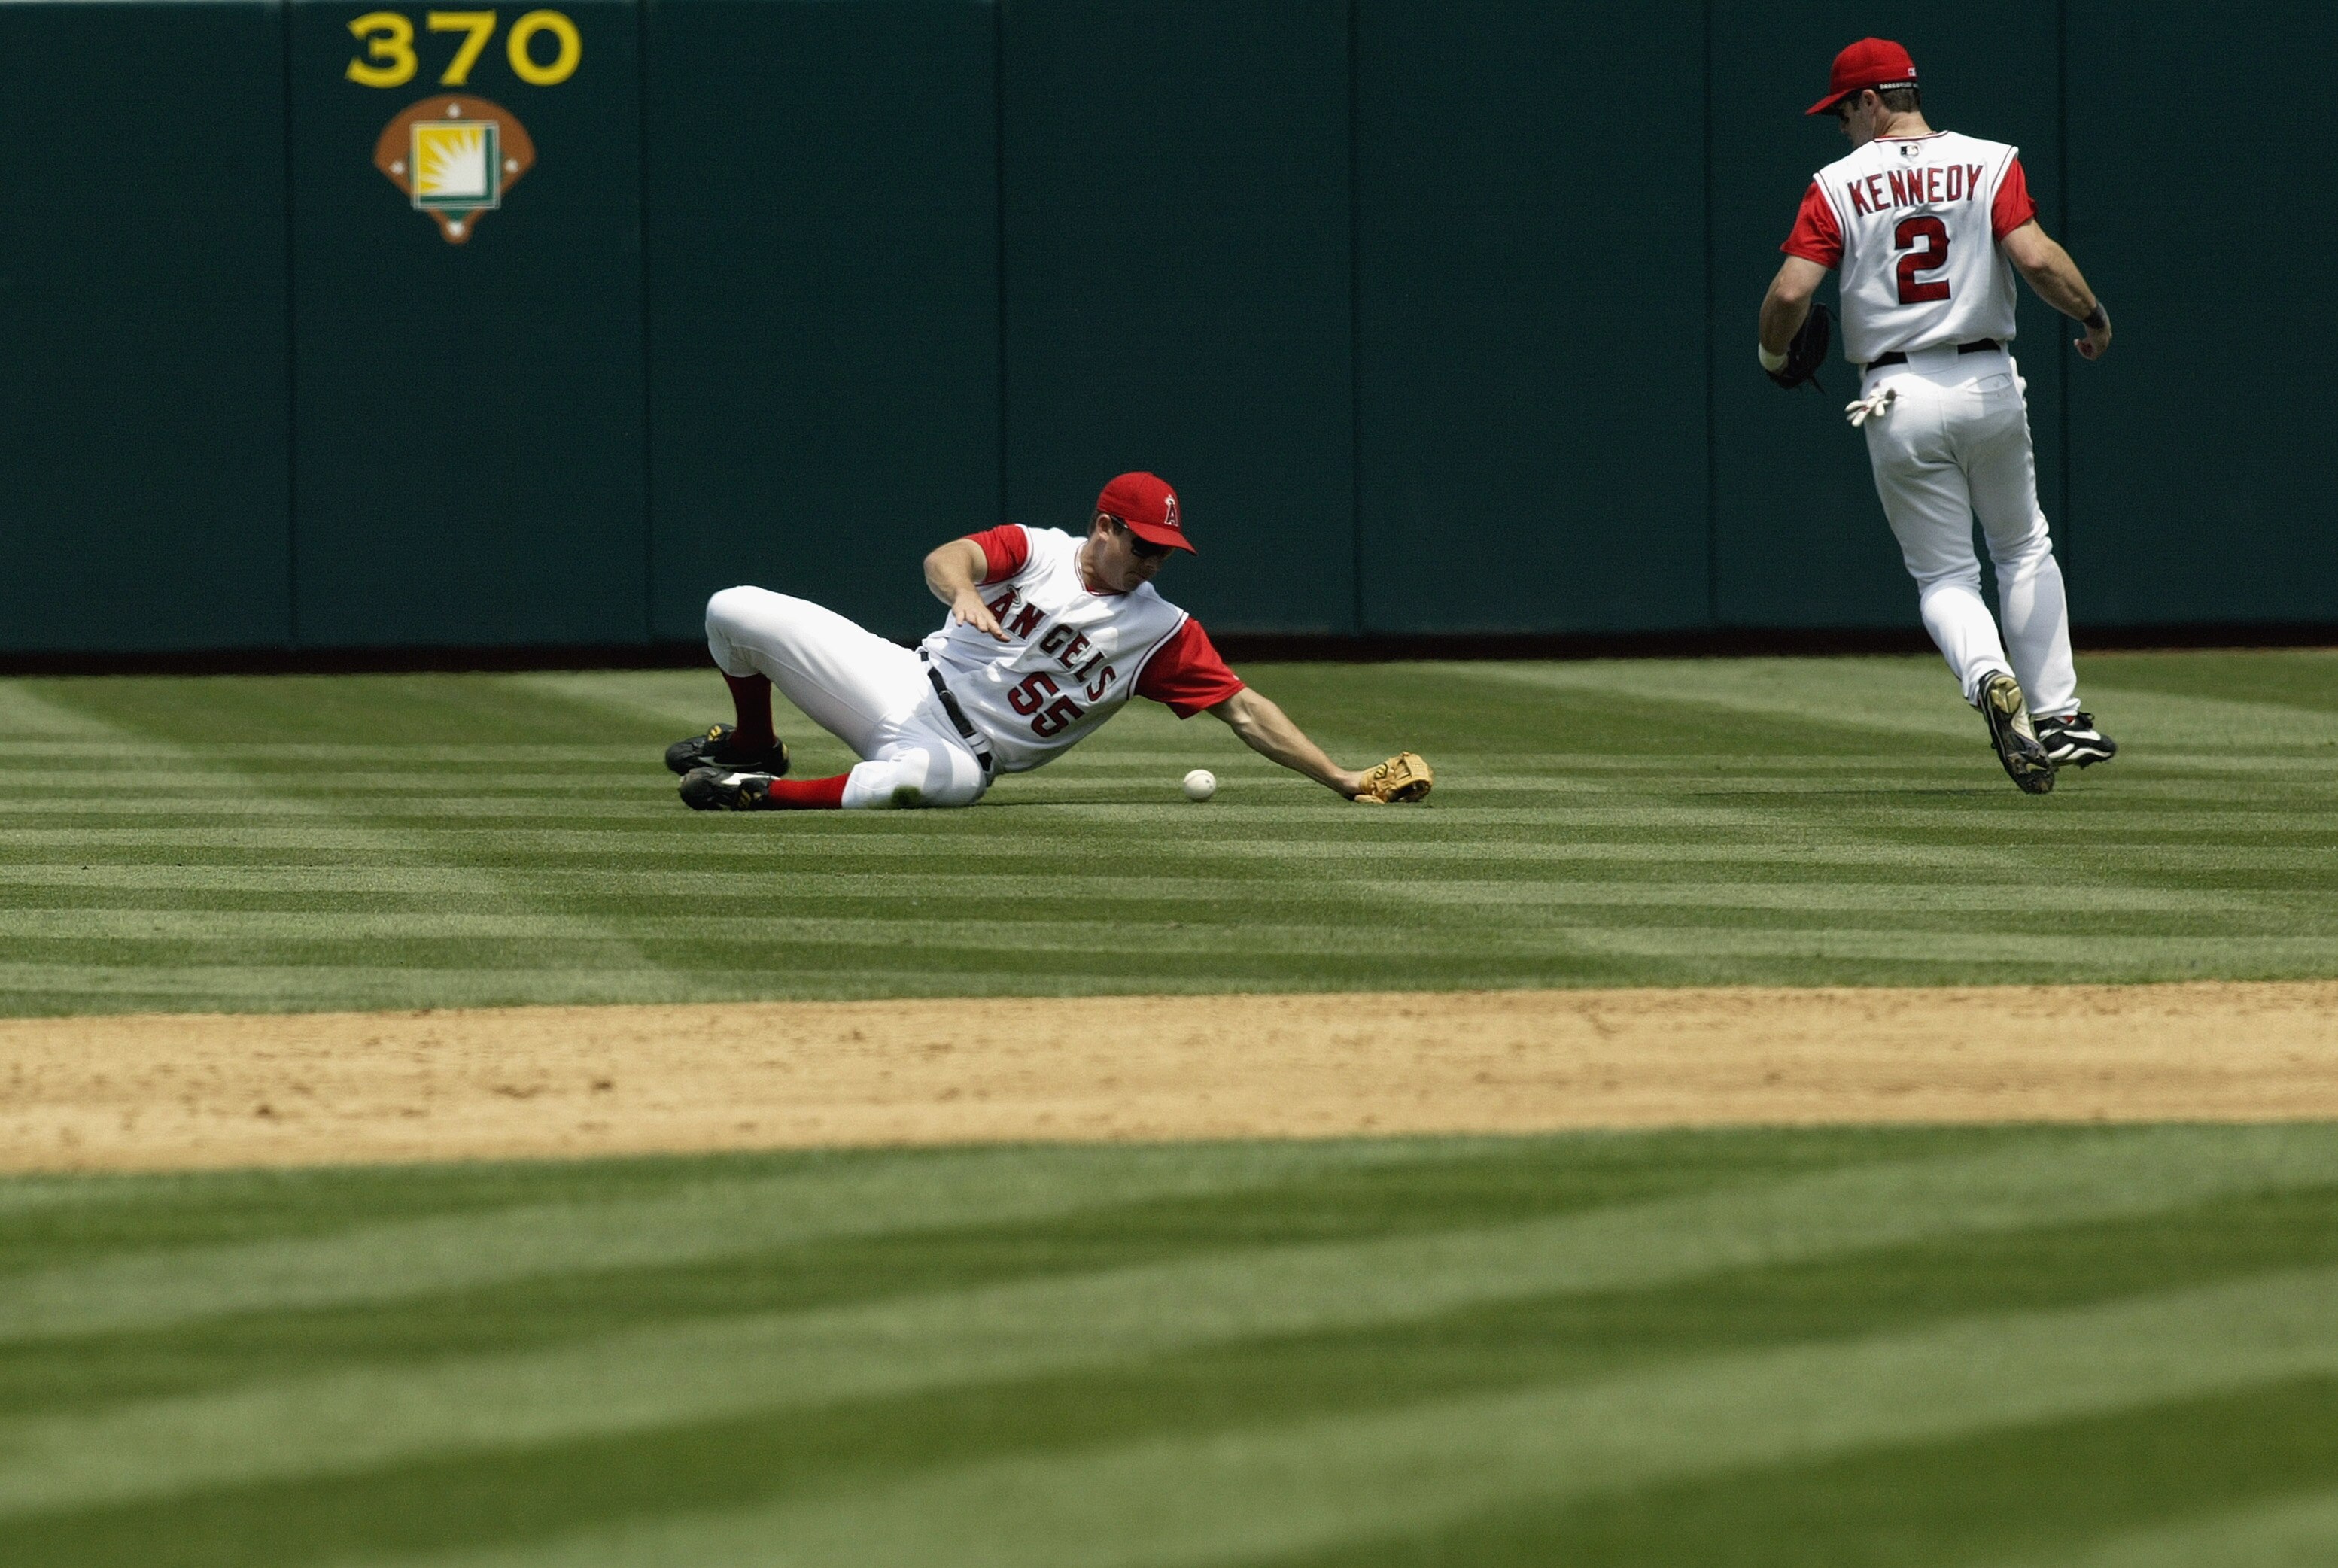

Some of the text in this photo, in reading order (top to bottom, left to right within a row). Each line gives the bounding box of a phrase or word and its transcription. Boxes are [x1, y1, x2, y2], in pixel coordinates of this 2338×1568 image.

[345, 9, 582, 88] 370
[1847, 163, 1984, 217] KENNEDY
[1894, 217, 1950, 304] 2
[1164, 495, 1179, 527] A
[987, 585, 1116, 703] ANGELS
[1008, 672, 1085, 738] 55
